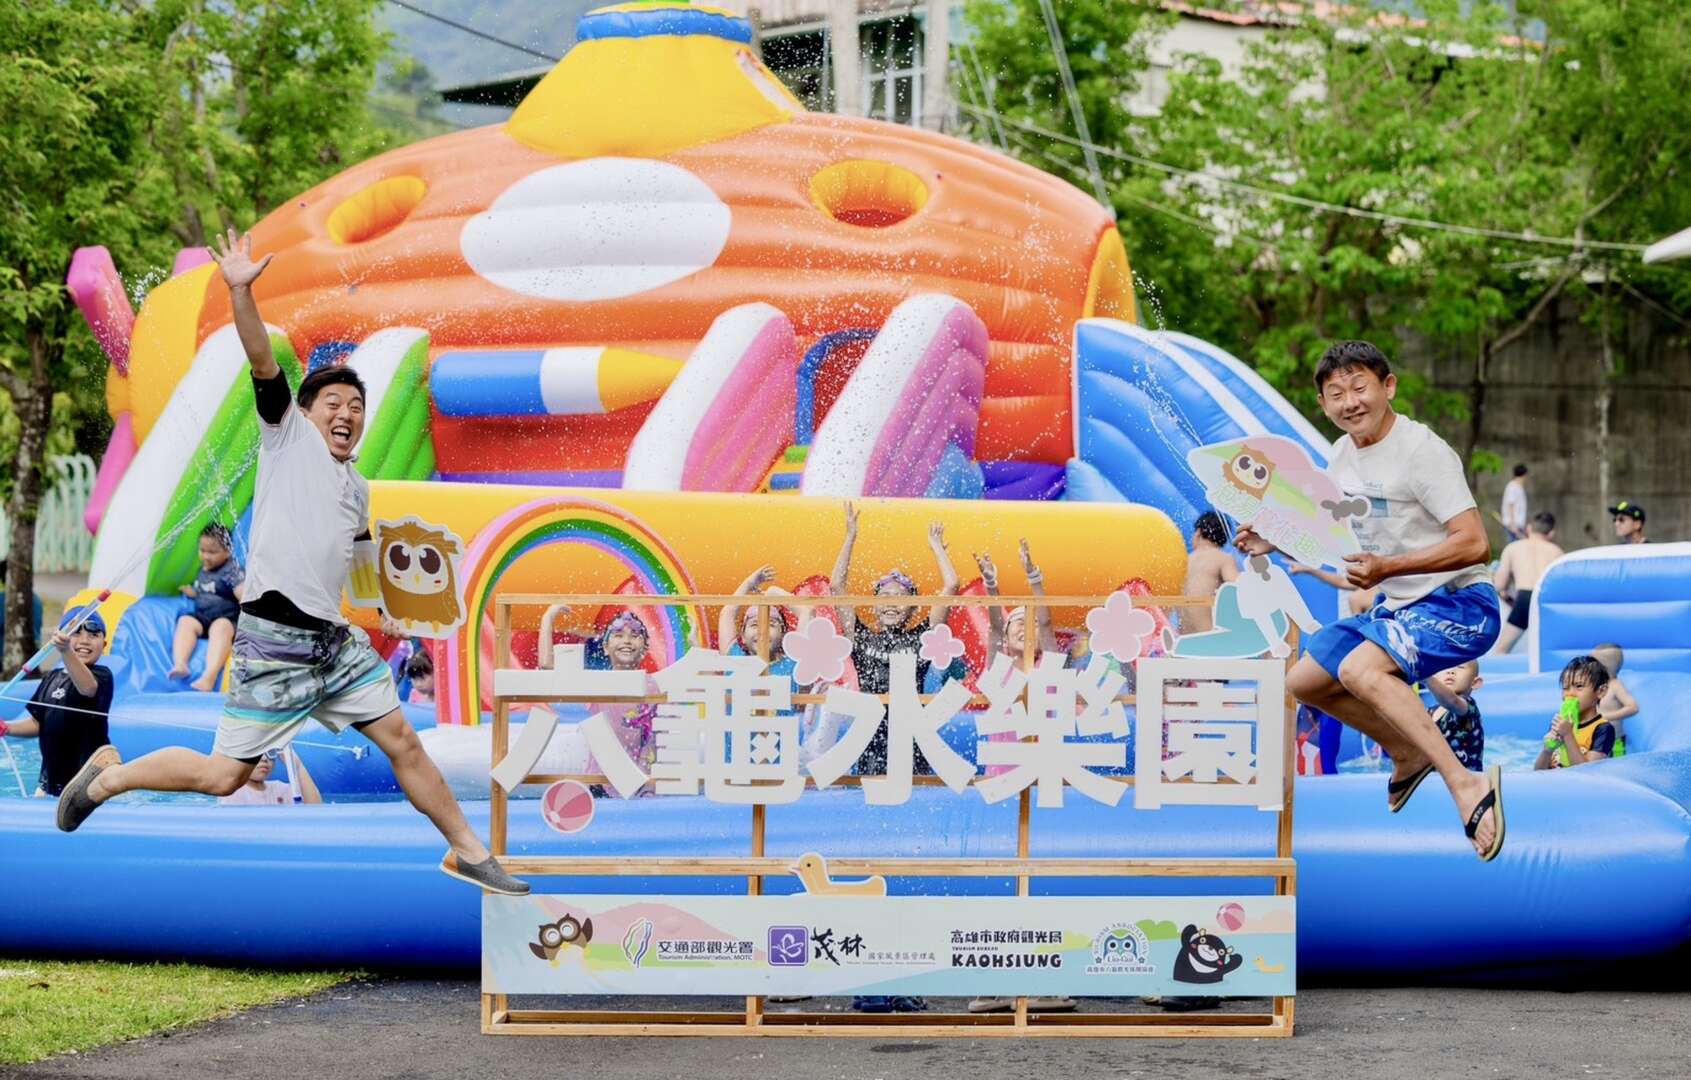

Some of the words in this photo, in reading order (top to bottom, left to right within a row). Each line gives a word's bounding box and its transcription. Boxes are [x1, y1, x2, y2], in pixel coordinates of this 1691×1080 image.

[489, 643, 1288, 812] 六龜水樂園
[950, 929, 1062, 944] 高雄市政府觀光局
[658, 941, 753, 953] 交通部觀光署
[810, 927, 866, 966] 茂林
[951, 954, 1062, 968] KAOHSIUNG
